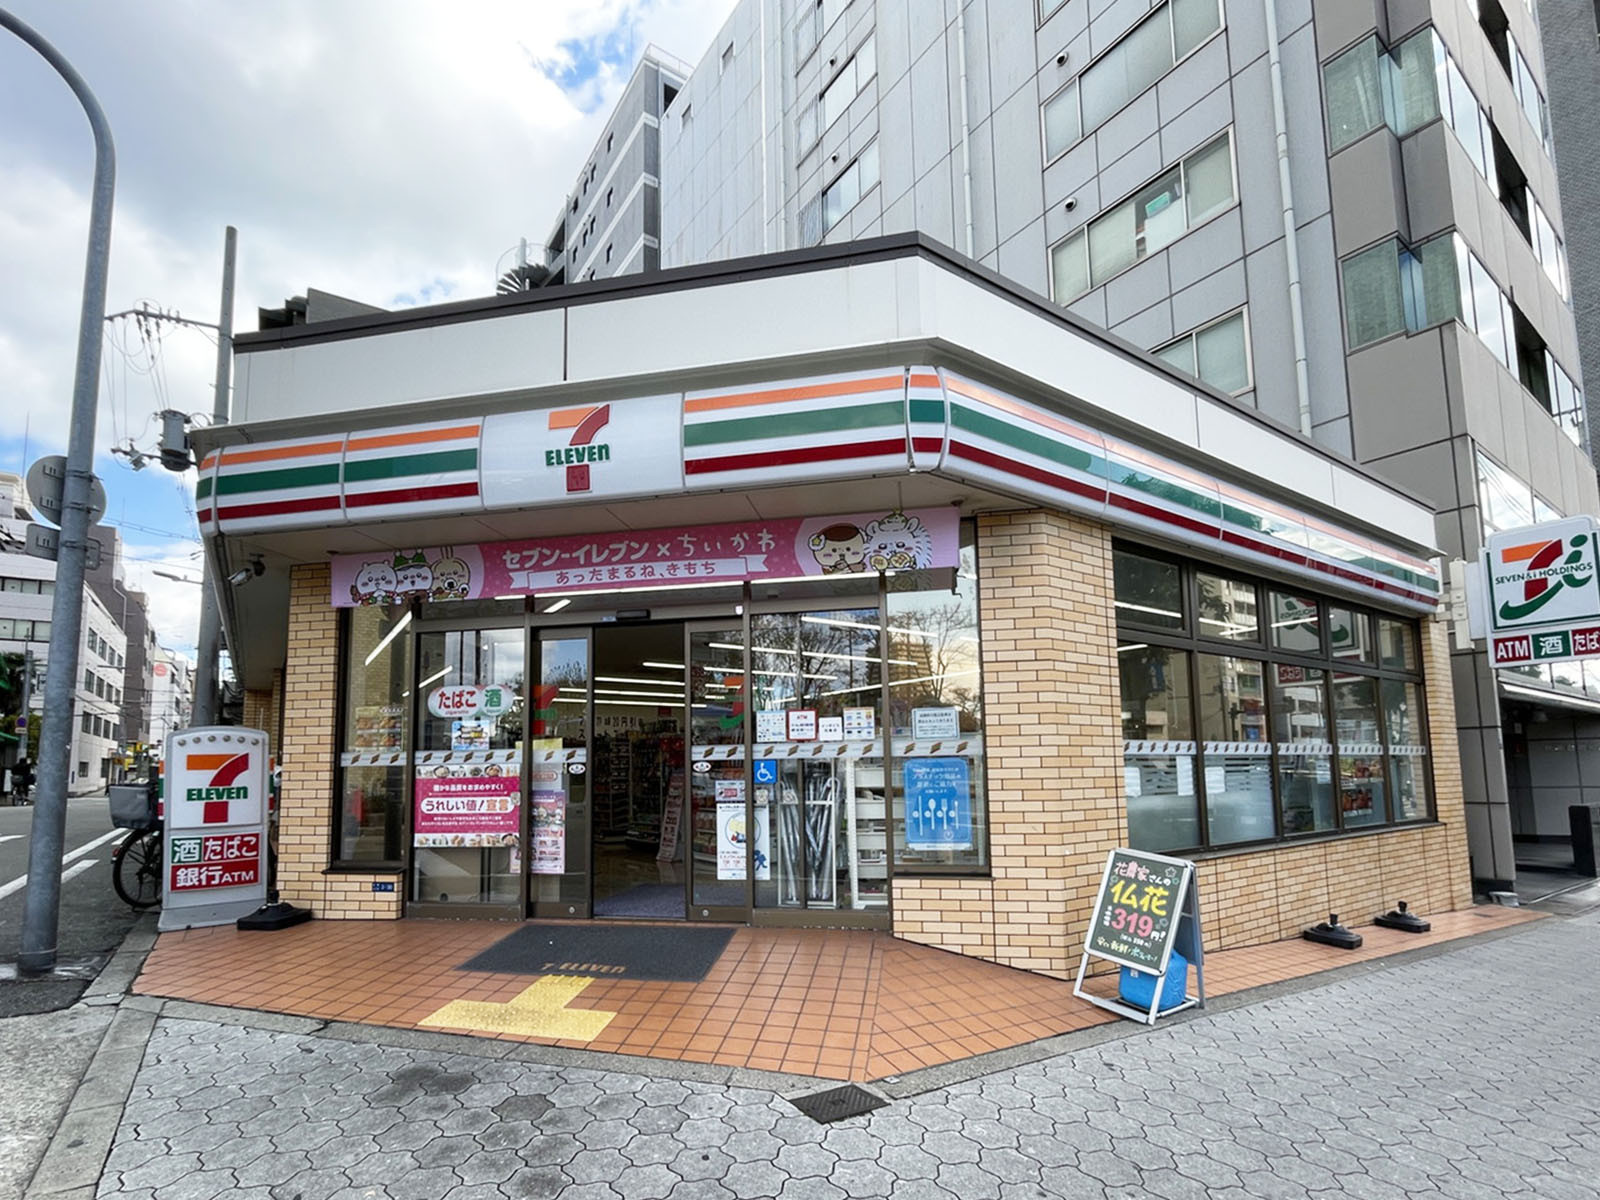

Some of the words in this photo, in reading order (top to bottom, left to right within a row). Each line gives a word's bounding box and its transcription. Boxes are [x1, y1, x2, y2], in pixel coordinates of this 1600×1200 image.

[545, 444, 610, 466] ELEVEN
[556, 561, 716, 585] あったまるね、きもち
[1538, 562, 1593, 577] HOLDINGS
[1497, 640, 1529, 659] ATM
[1539, 636, 1563, 656] 酒
[438, 689, 477, 709] たばこ
[484, 689, 502, 707] 酒
[187, 786, 248, 801] ELEVEN
[174, 839, 202, 863] 酒
[204, 836, 257, 861] たばこ
